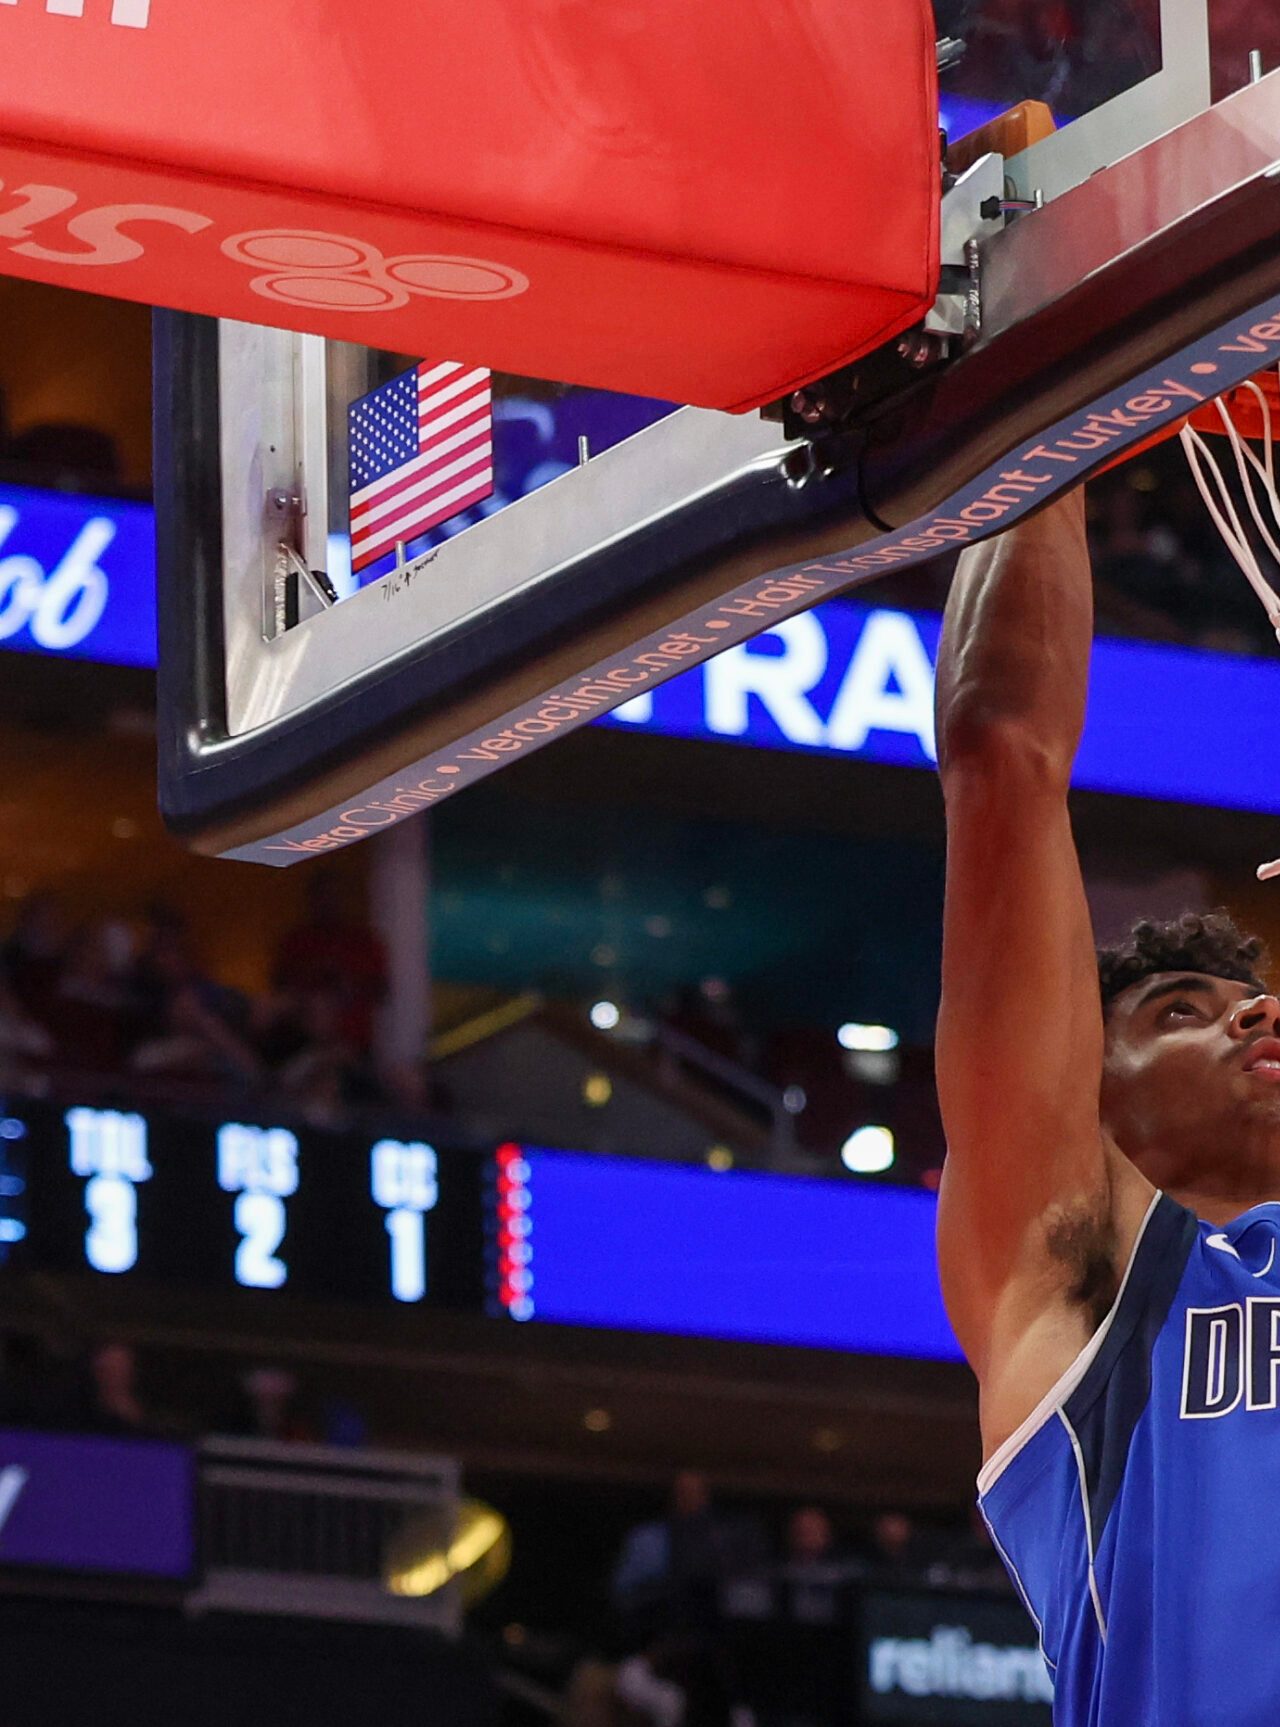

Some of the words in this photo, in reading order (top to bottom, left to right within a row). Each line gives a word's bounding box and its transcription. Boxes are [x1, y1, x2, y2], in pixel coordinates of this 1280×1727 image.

[456, 632, 720, 761] veraclinic.net
[719, 573, 826, 617] Hair
[803, 469, 1052, 573] Transplant
[1022, 379, 1206, 462] Turkey
[610, 608, 938, 763] RA
[84, 1174, 138, 1273] 3
[233, 1191, 288, 1288] 2
[384, 1207, 427, 1302] 1
